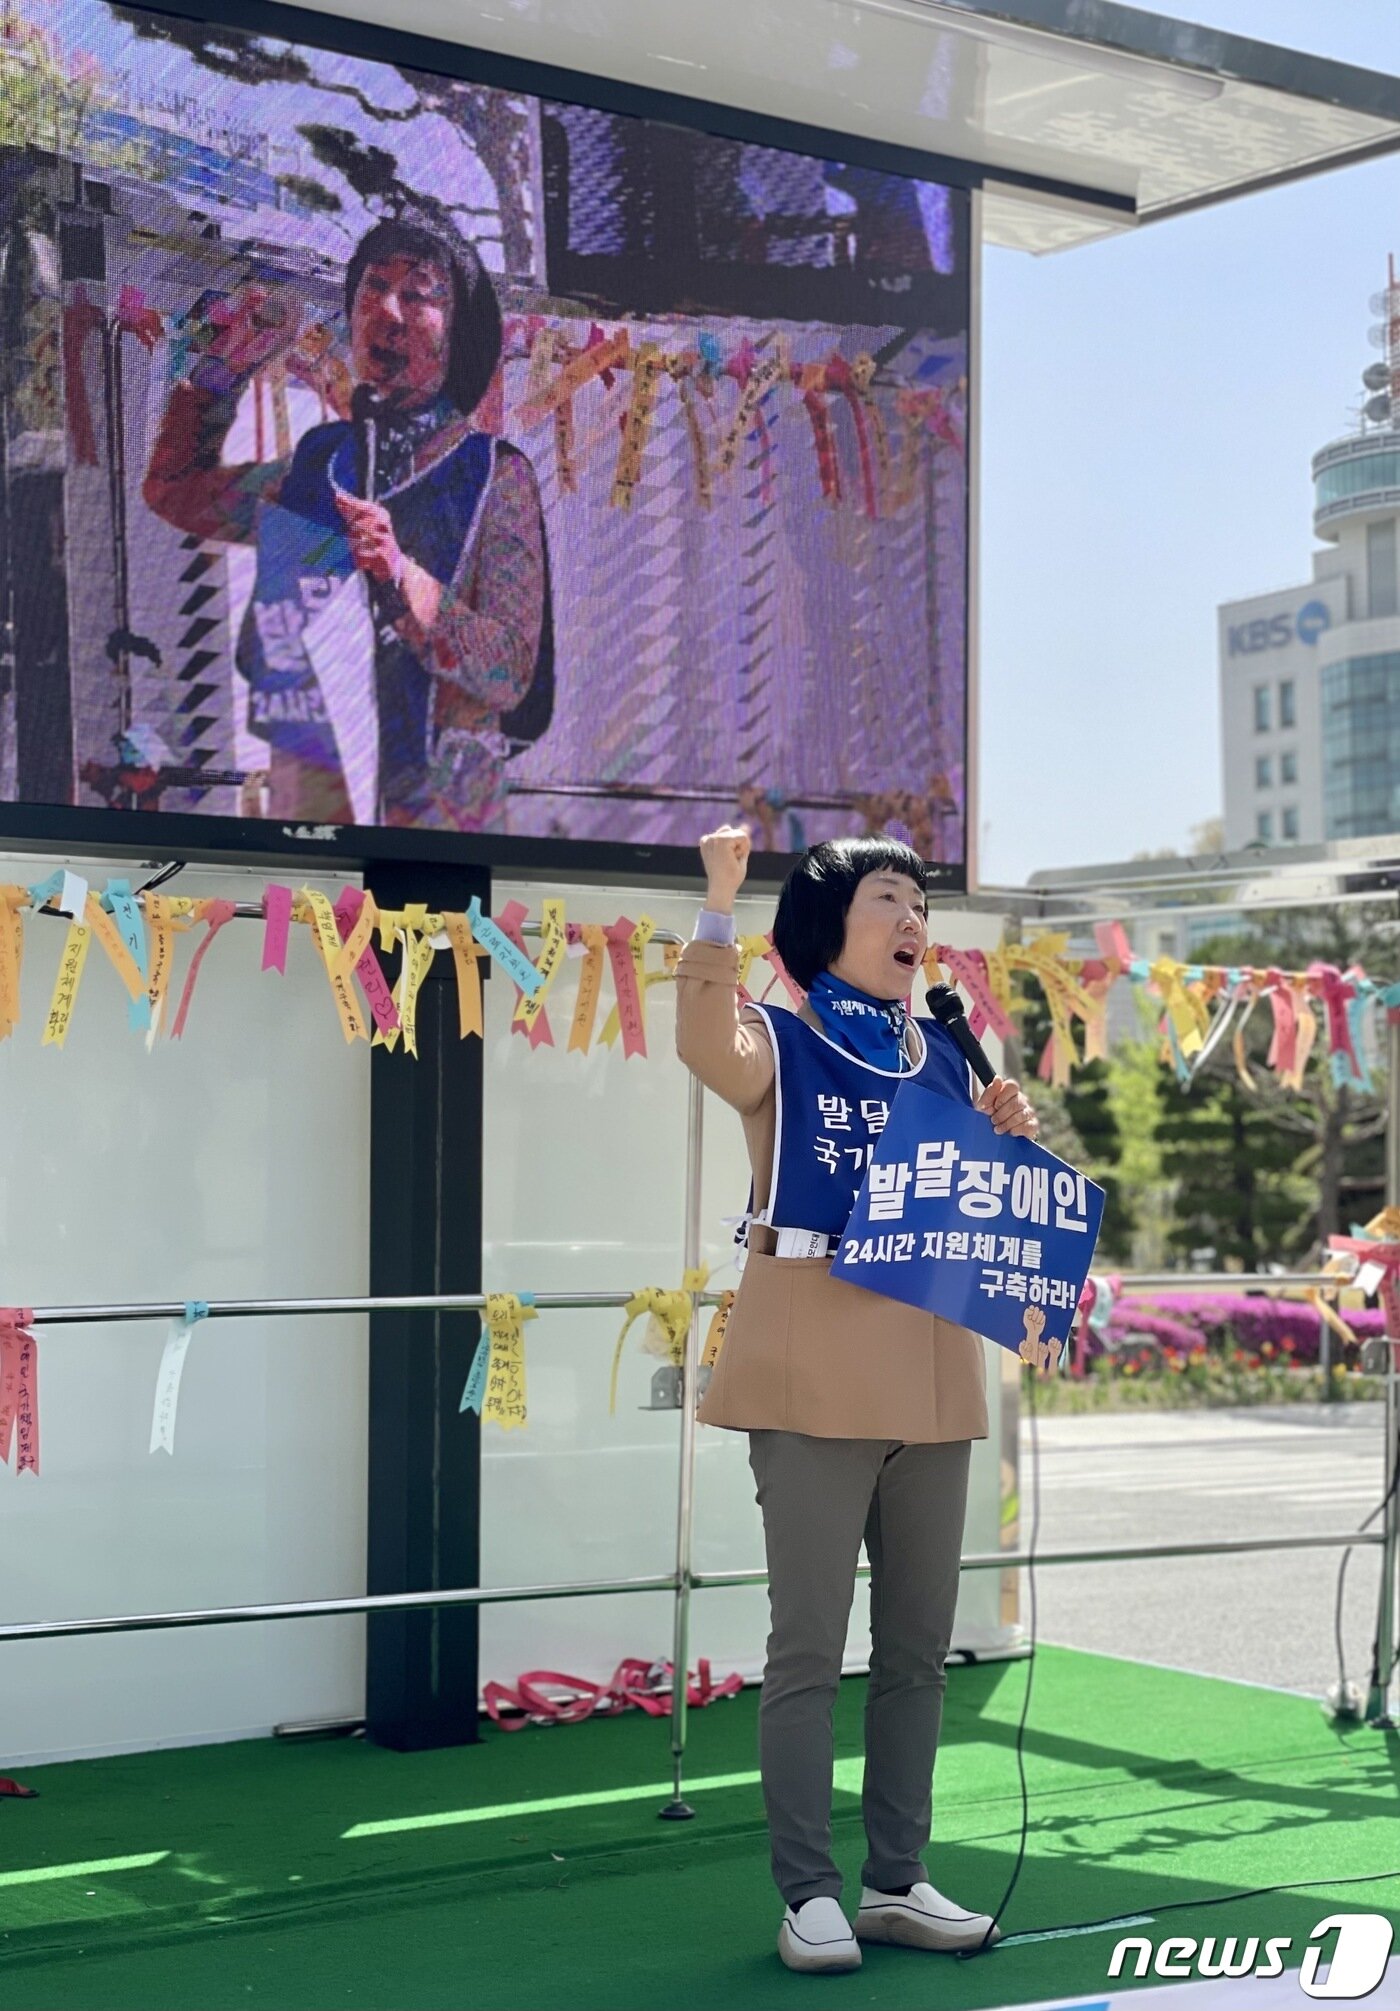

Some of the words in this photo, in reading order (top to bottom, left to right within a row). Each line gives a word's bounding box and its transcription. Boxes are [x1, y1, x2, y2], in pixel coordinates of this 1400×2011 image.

[1228, 613, 1292, 657] KBS
[868, 1141, 1089, 1234] 발달장애인
[844, 1232, 916, 1265] 24시간
[920, 1231, 1043, 1270] 지원체계를
[979, 1267, 1077, 1310] 구축하라!
